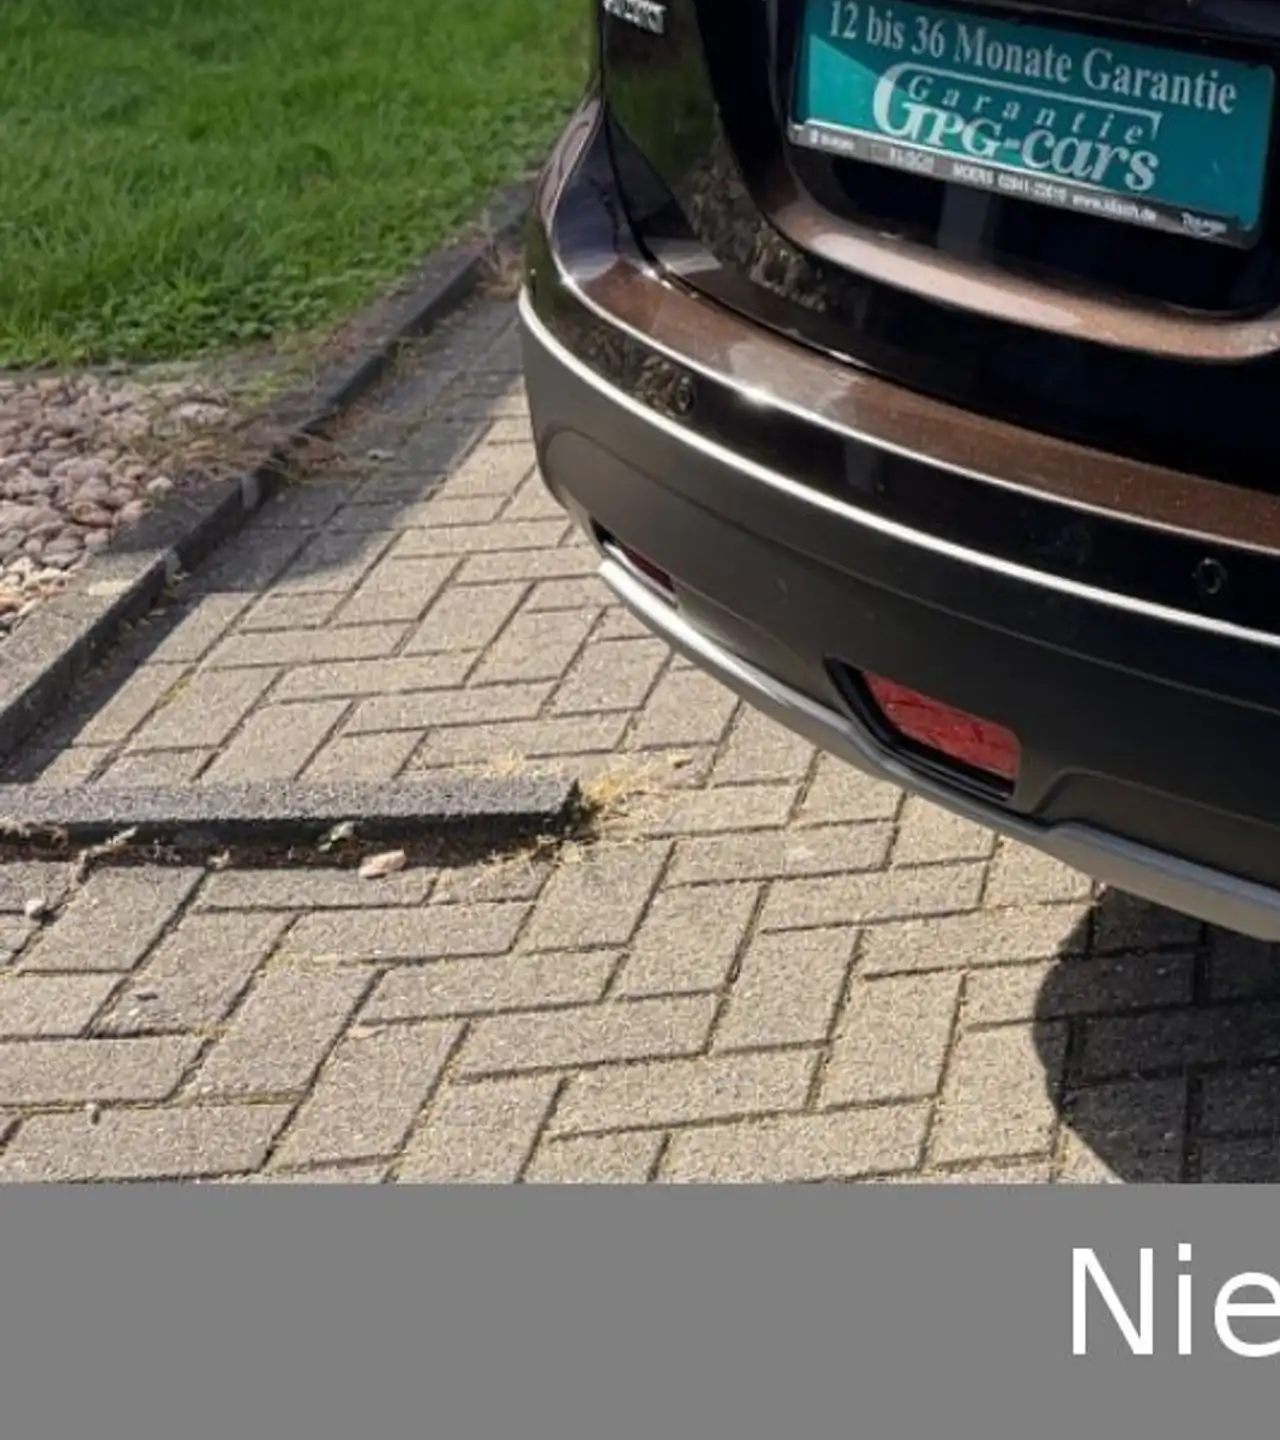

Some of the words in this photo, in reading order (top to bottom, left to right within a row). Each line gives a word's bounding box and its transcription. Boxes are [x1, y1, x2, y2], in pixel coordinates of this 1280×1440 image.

[867, 7, 902, 51] bis
[911, 14, 946, 59] 36
[955, 23, 1072, 84] Monate
[1082, 47, 1239, 115] Garantie
[907, 73, 1145, 145] Garantie
[873, 62, 1161, 193] GPG-cars
